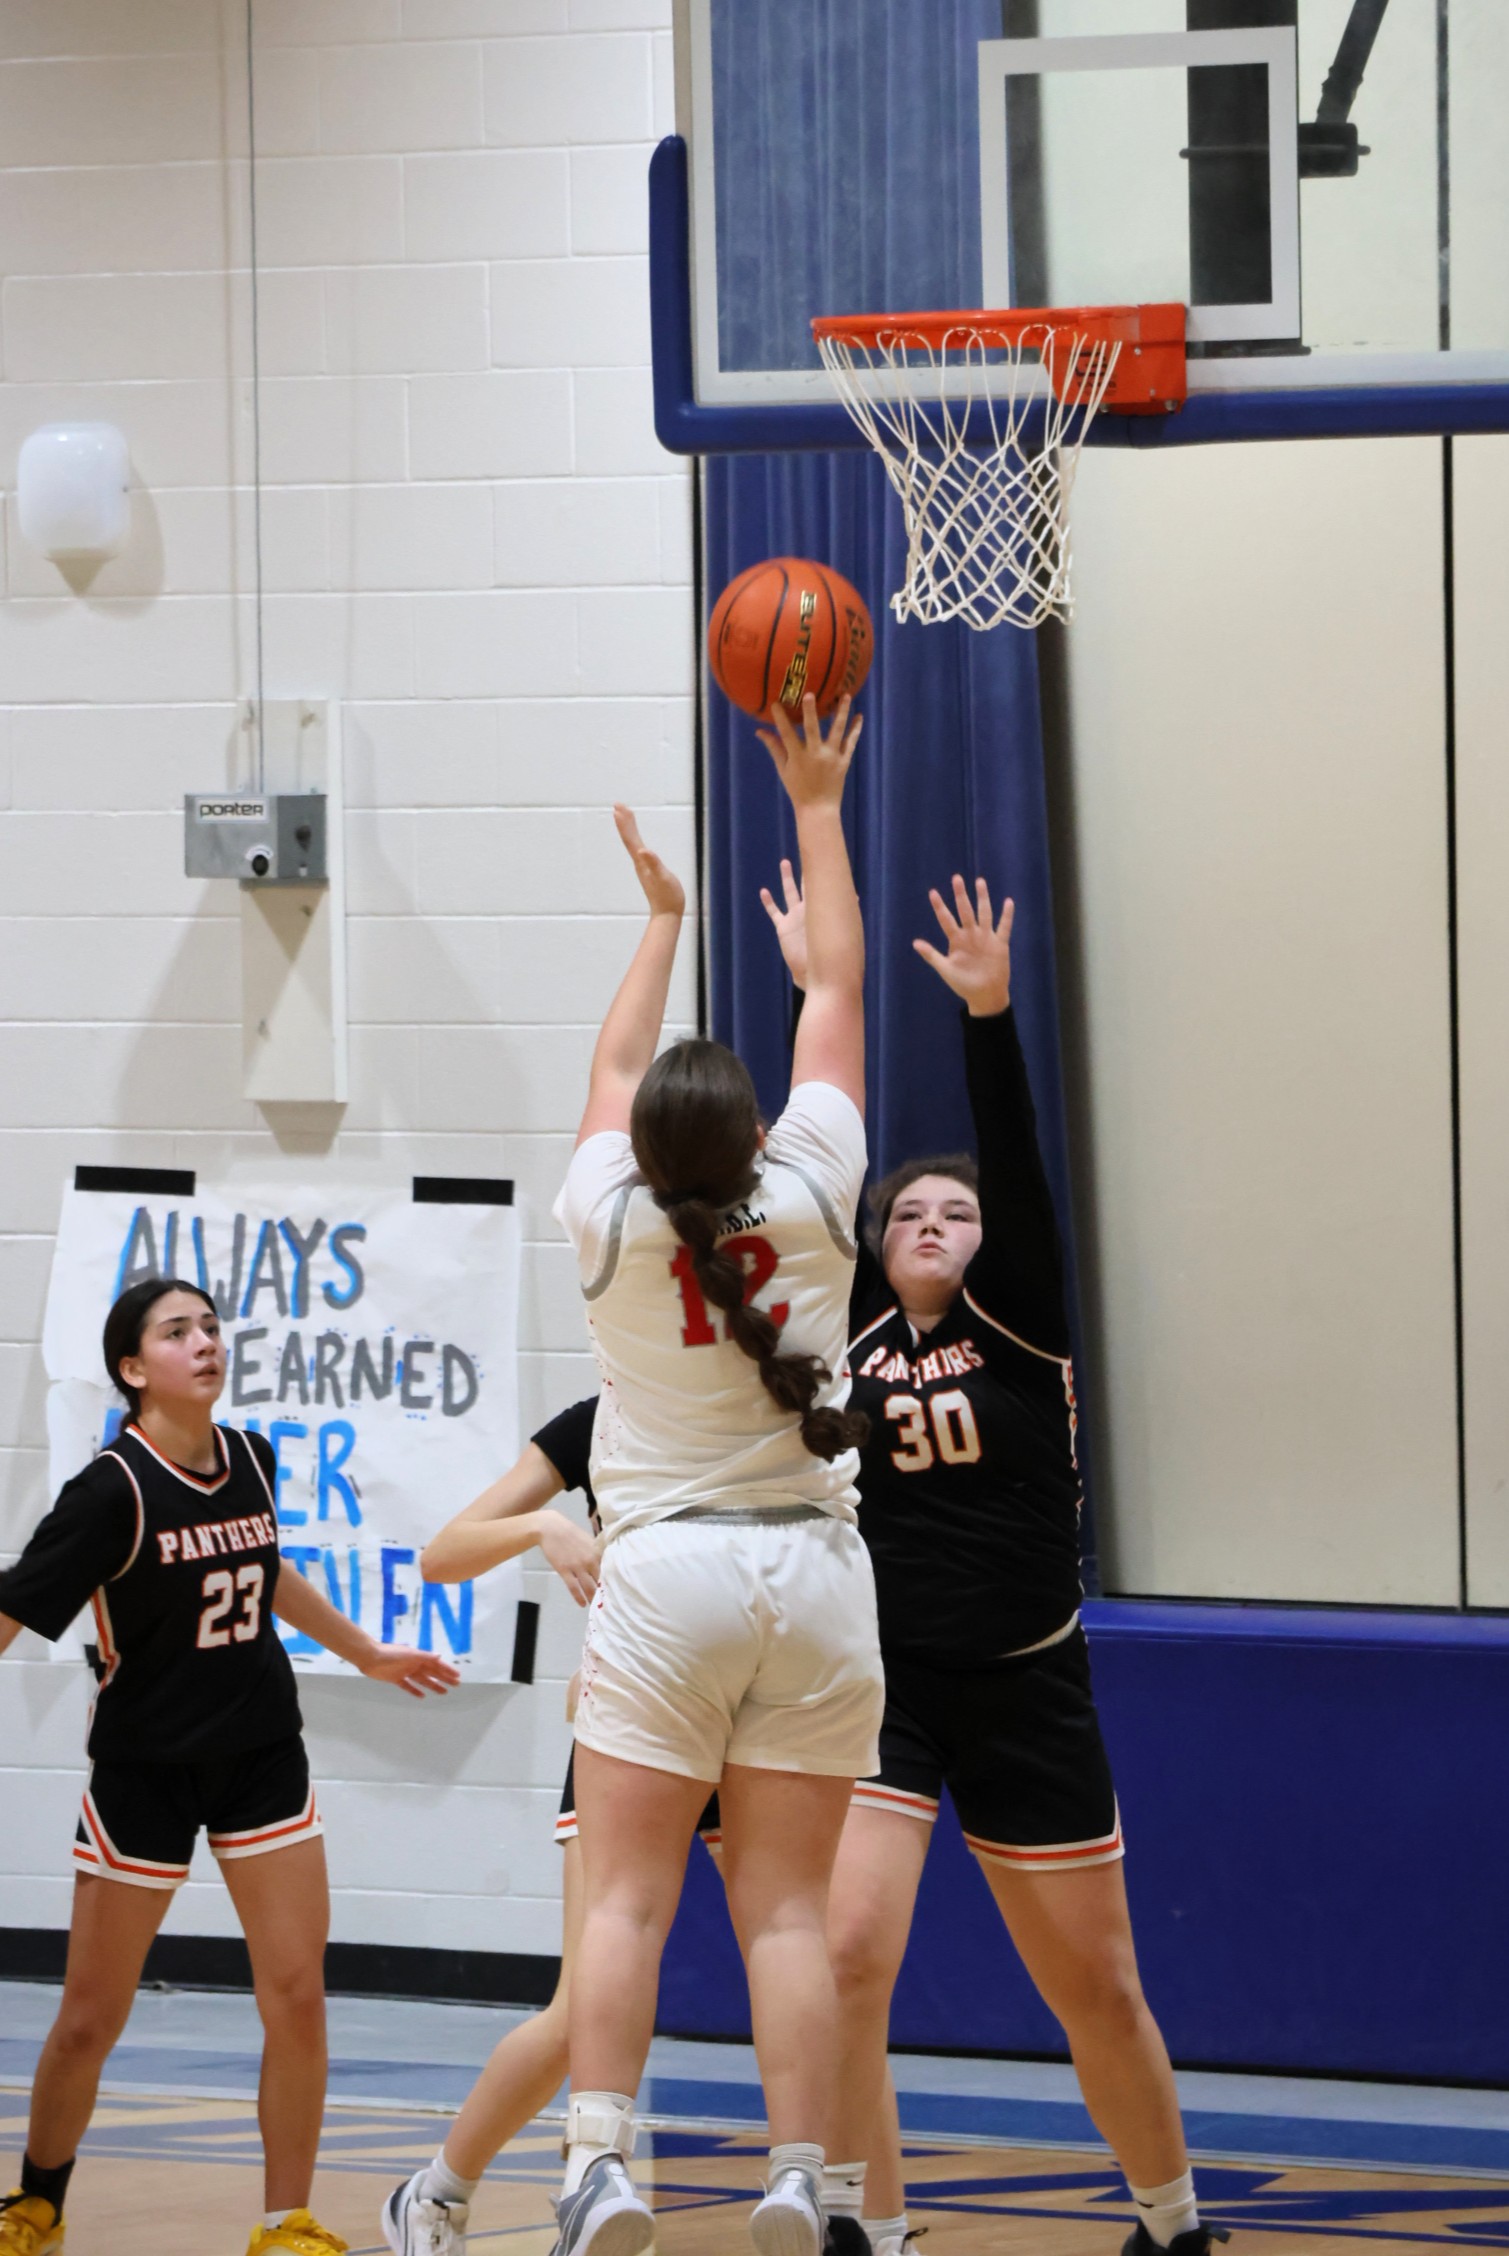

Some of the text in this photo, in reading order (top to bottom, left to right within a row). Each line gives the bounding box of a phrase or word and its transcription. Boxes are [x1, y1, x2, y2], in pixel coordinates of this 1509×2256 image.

[669, 1235, 790, 1347] 12
[231, 1327, 479, 1417] EARNED
[884, 1388, 982, 1472] 30
[156, 1512, 276, 1564] PANTHERS
[196, 1562, 264, 1649] 23
[272, 1546, 474, 1658] IVEN
